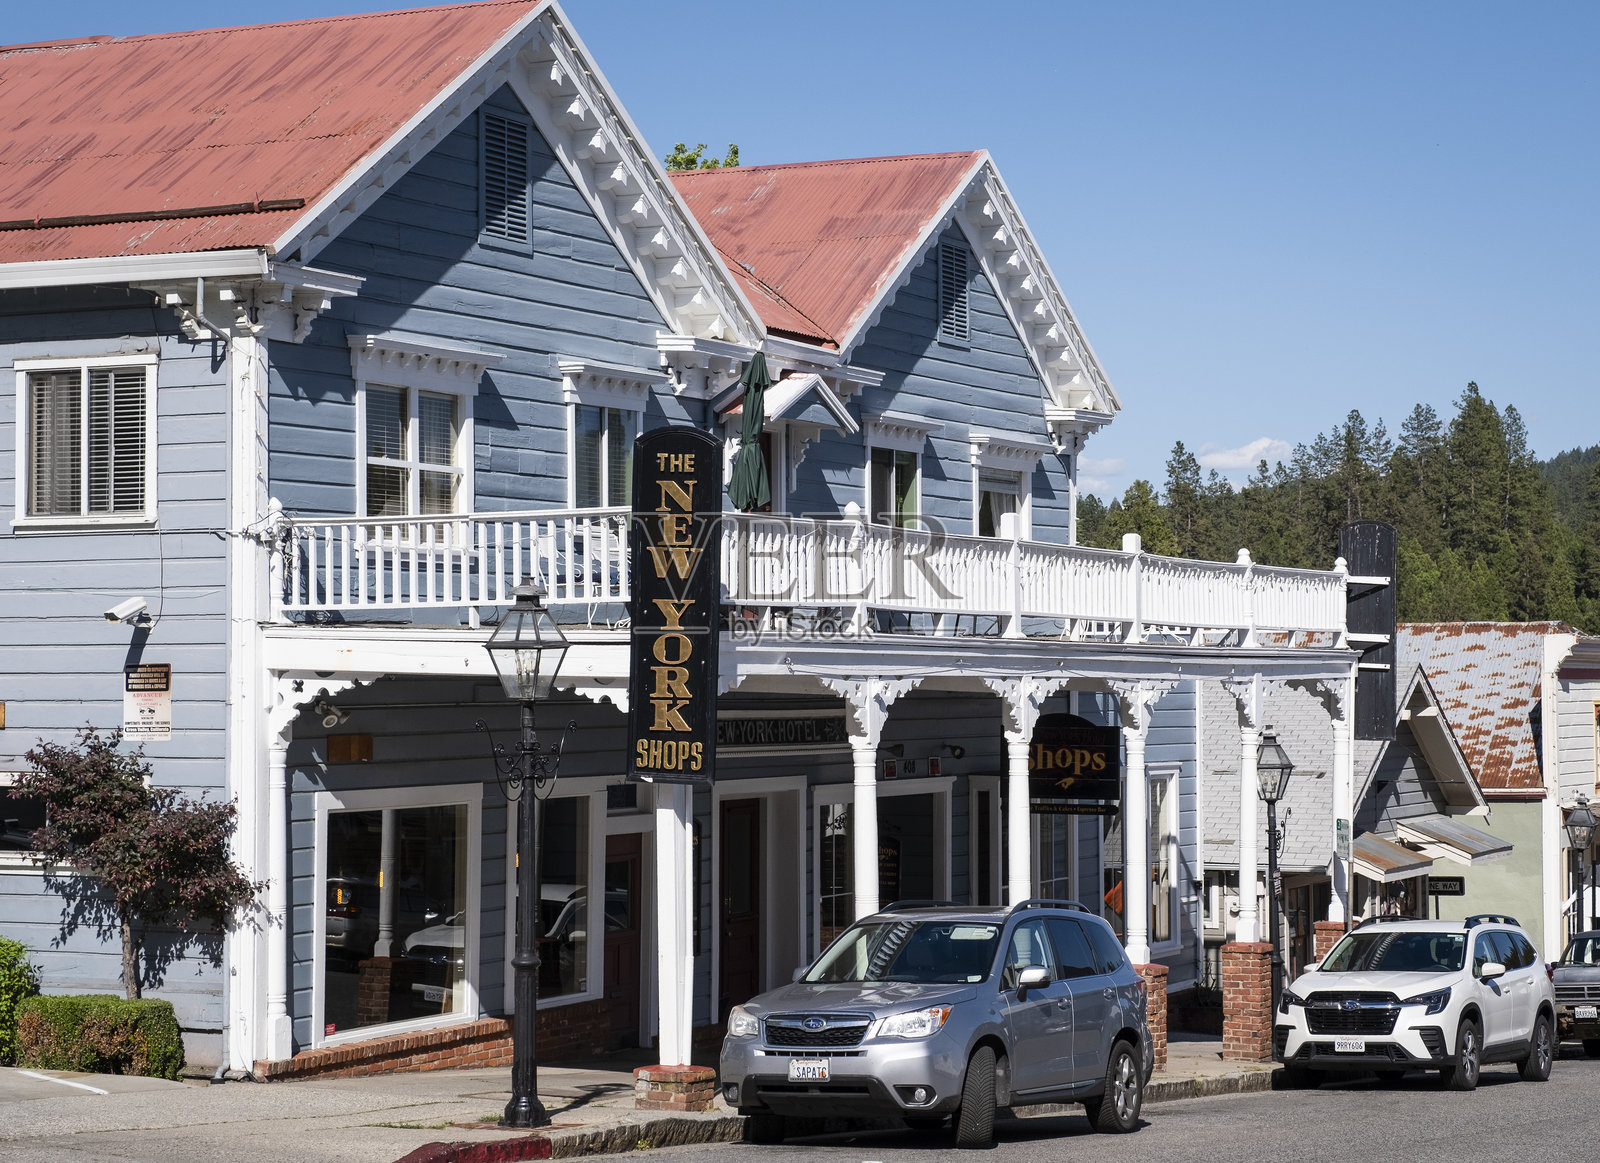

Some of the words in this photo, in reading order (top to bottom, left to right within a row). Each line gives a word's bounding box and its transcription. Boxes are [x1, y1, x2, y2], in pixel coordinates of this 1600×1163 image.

[656, 453, 695, 472] THE
[646, 480, 703, 578] NEW
[650, 599, 696, 732] YORK
[717, 721, 736, 743] EW
[739, 721, 775, 743] YORK
[778, 720, 821, 742] HOTEL
[636, 738, 703, 771] SHOPS
[904, 760, 916, 774] 408
[1429, 882, 1440, 890] NE
[1442, 882, 1458, 890] WAY
